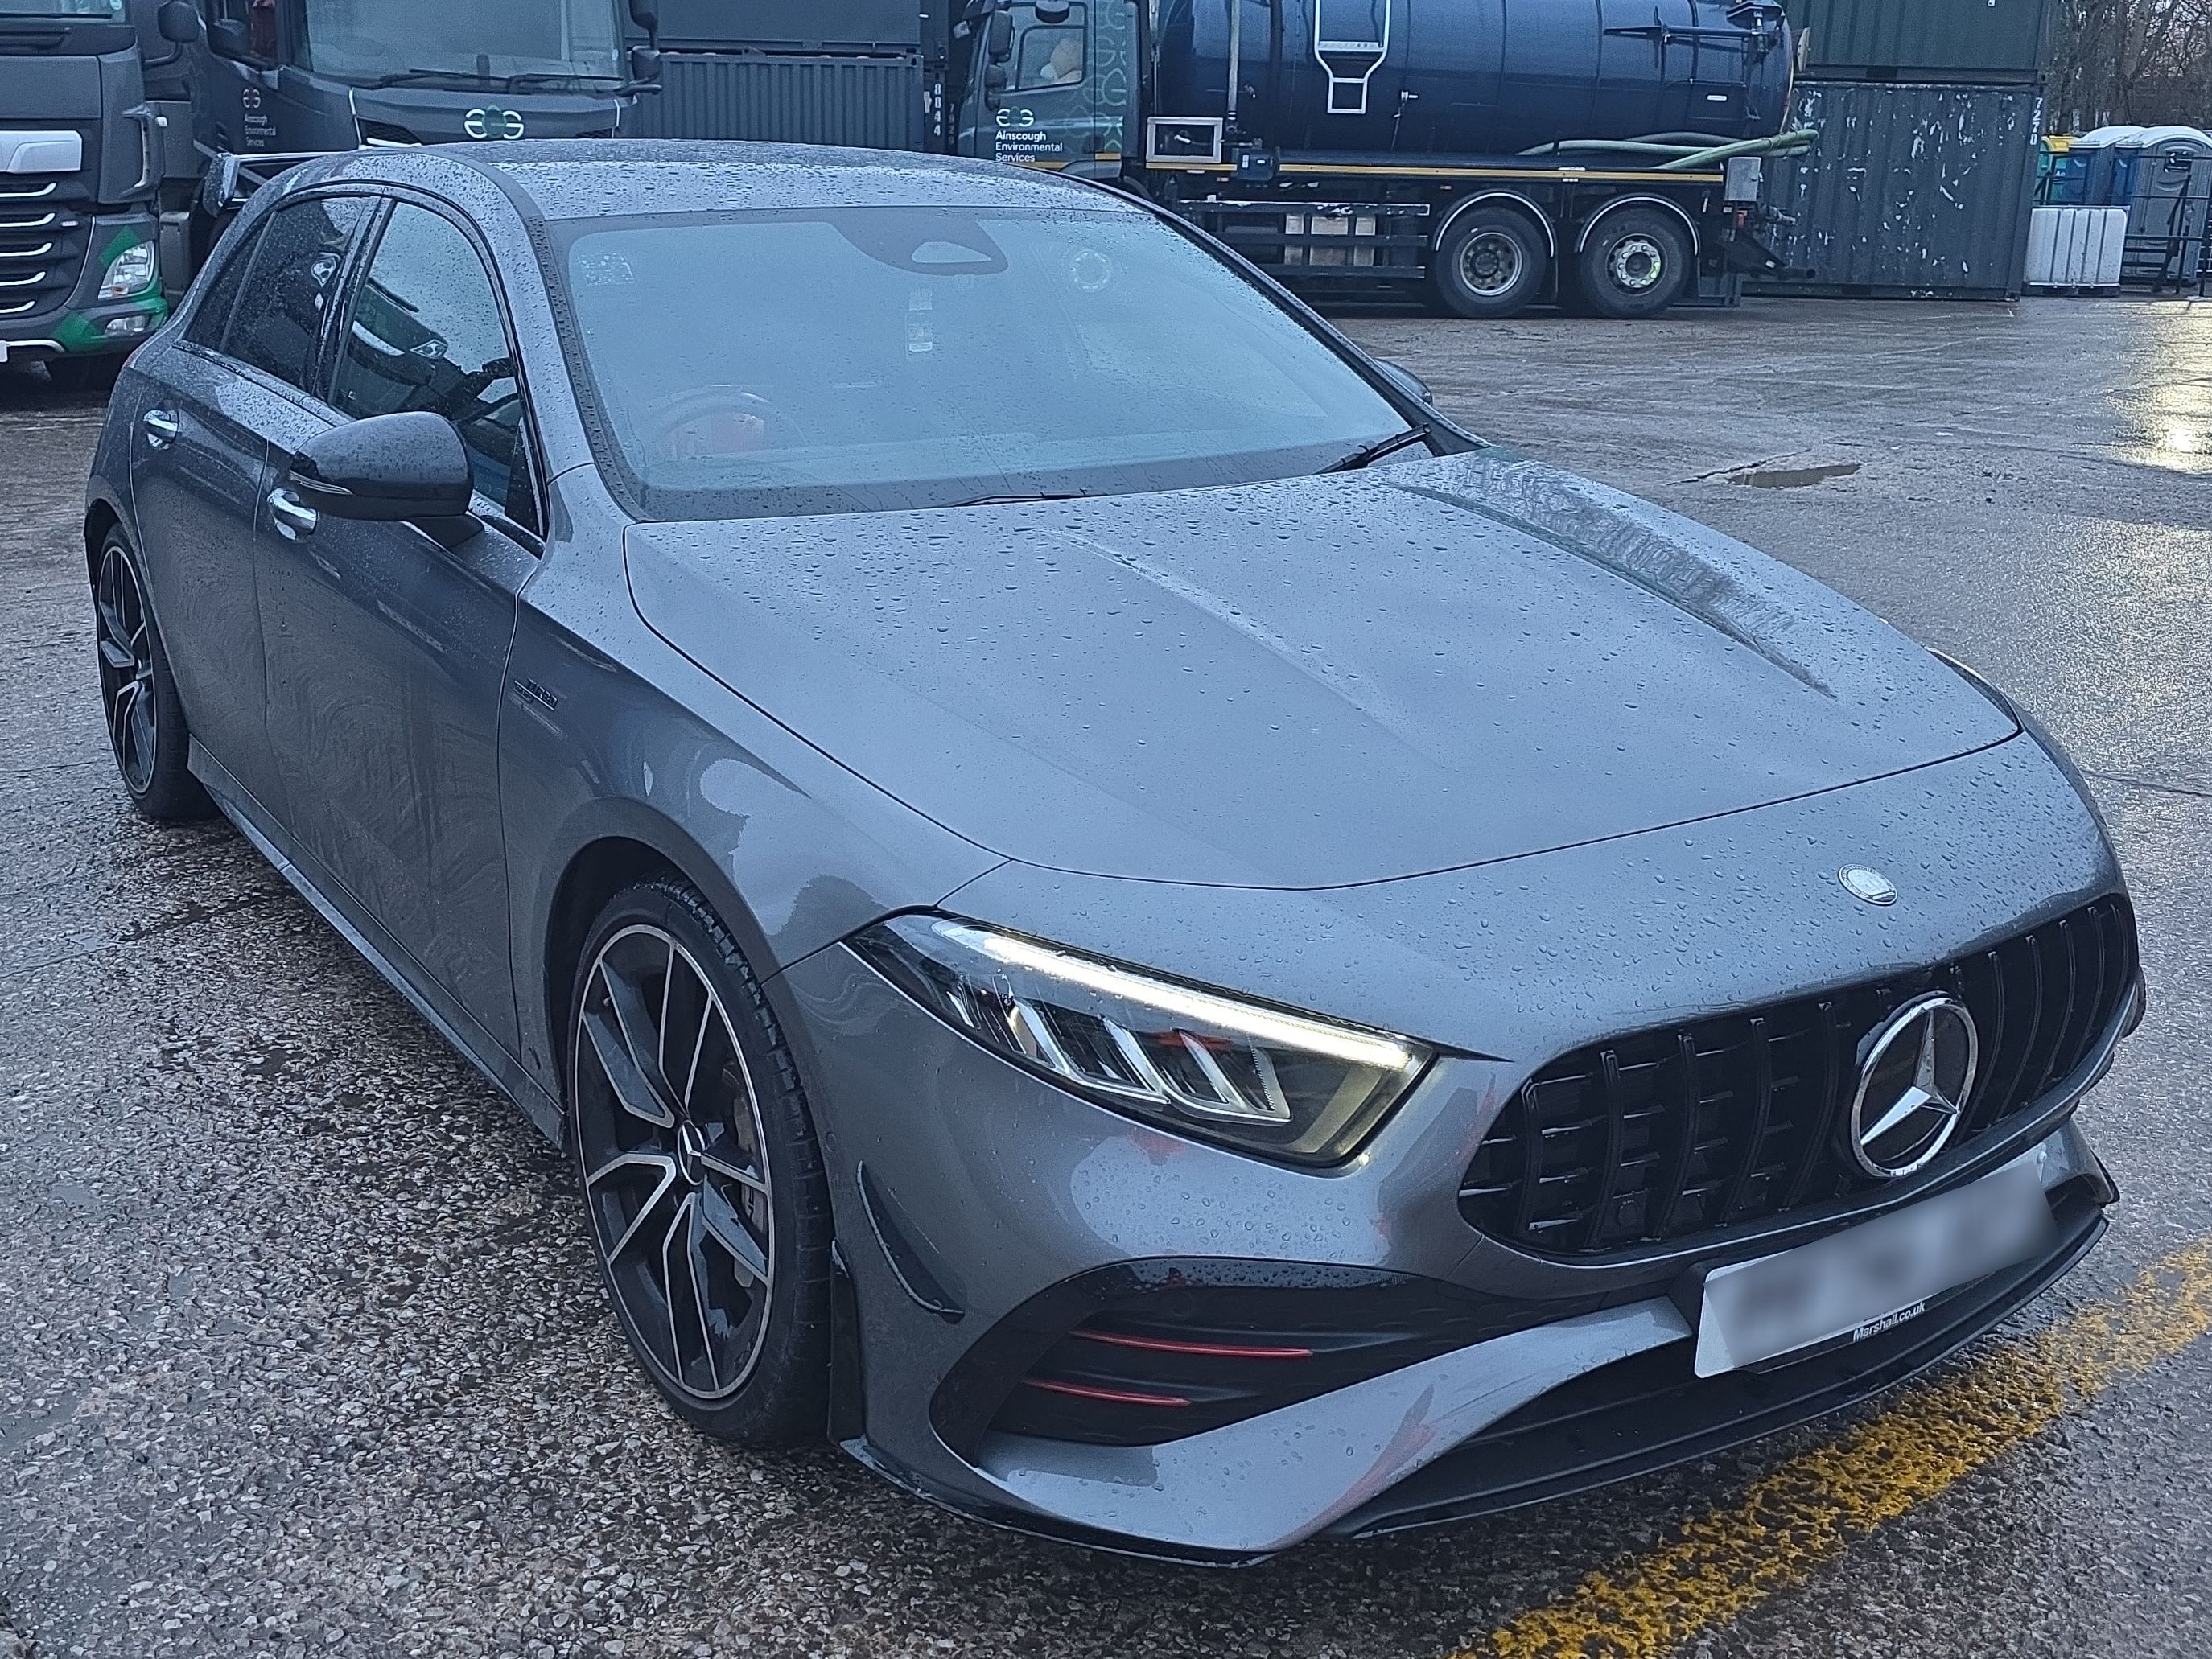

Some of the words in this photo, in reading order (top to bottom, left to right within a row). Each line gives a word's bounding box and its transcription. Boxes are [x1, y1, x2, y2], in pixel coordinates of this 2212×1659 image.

[2029, 97, 2044, 146] 7270
[995, 130, 1047, 143] Ainscough
[995, 141, 1063, 152] Environmental
[995, 152, 1036, 163] Services
[1852, 1301, 1926, 1342] Marshall.co.uk
